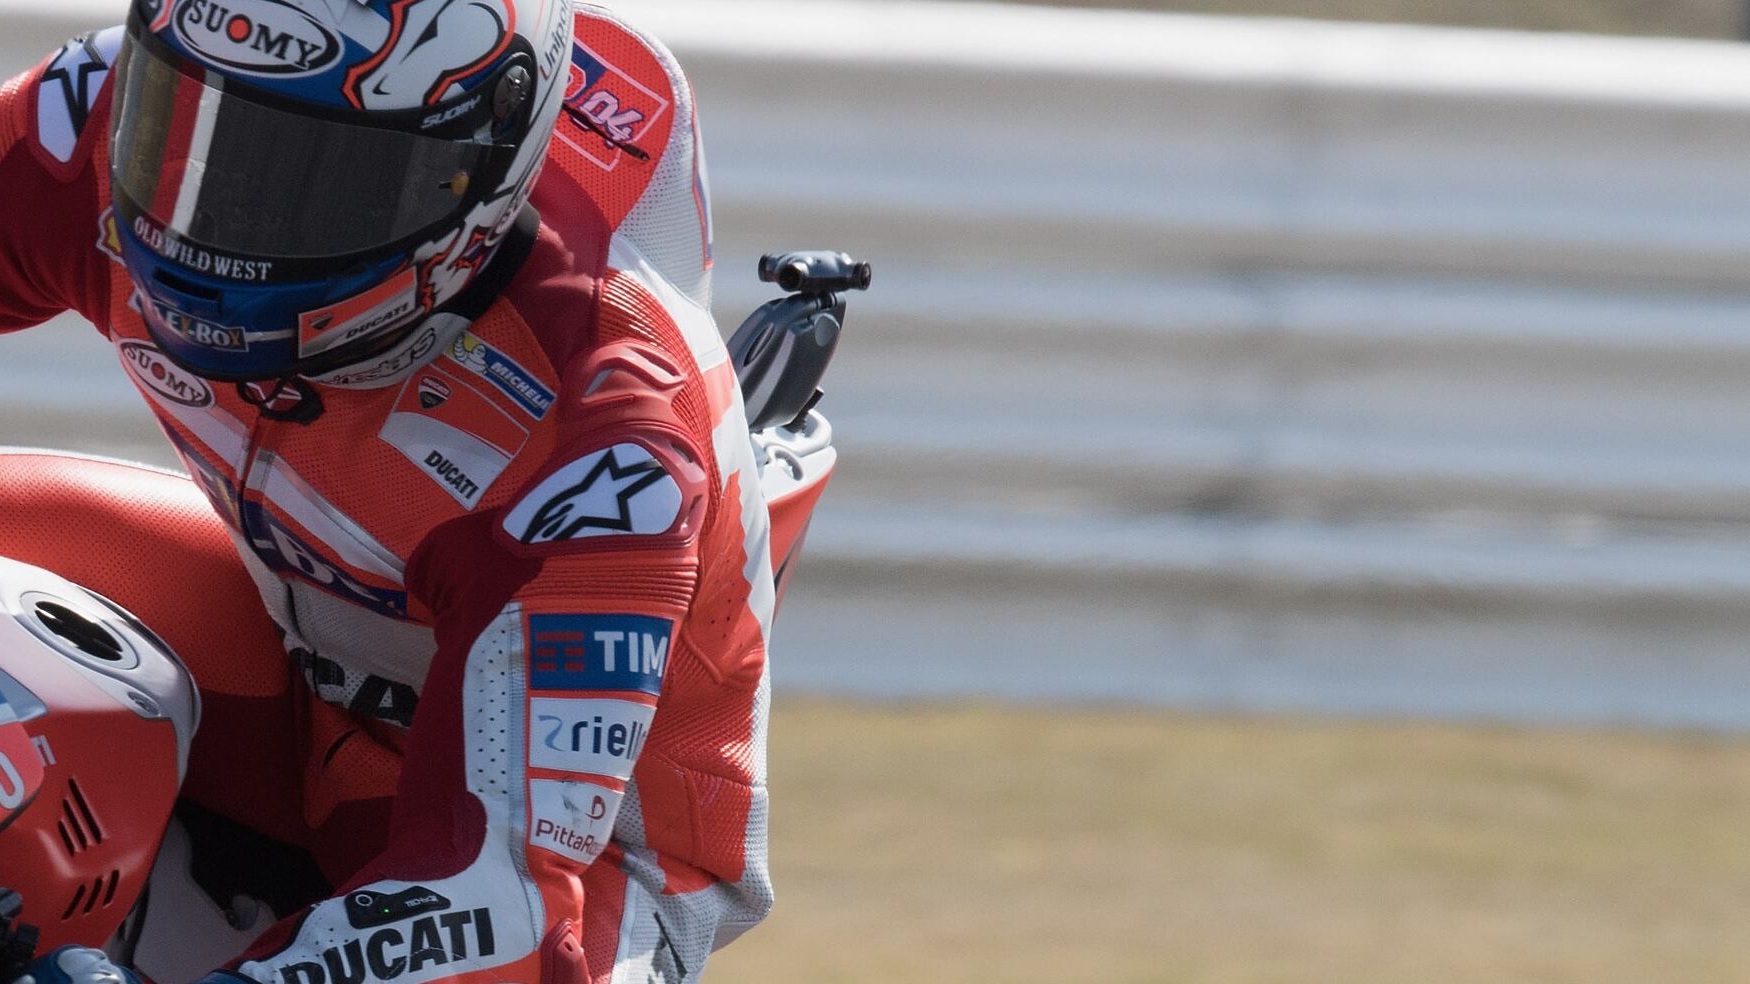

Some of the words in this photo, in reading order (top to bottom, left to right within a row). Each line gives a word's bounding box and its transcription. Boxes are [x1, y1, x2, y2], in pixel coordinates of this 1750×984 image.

[188, 0, 322, 68] SUOMY
[134, 215, 163, 249] OLD
[164, 239, 211, 271] WILD
[214, 254, 273, 281] WEST
[346, 301, 410, 339] DUCATI
[126, 345, 203, 402] SUOMY
[424, 450, 480, 500] DUCATI
[593, 630, 668, 678] TIM
